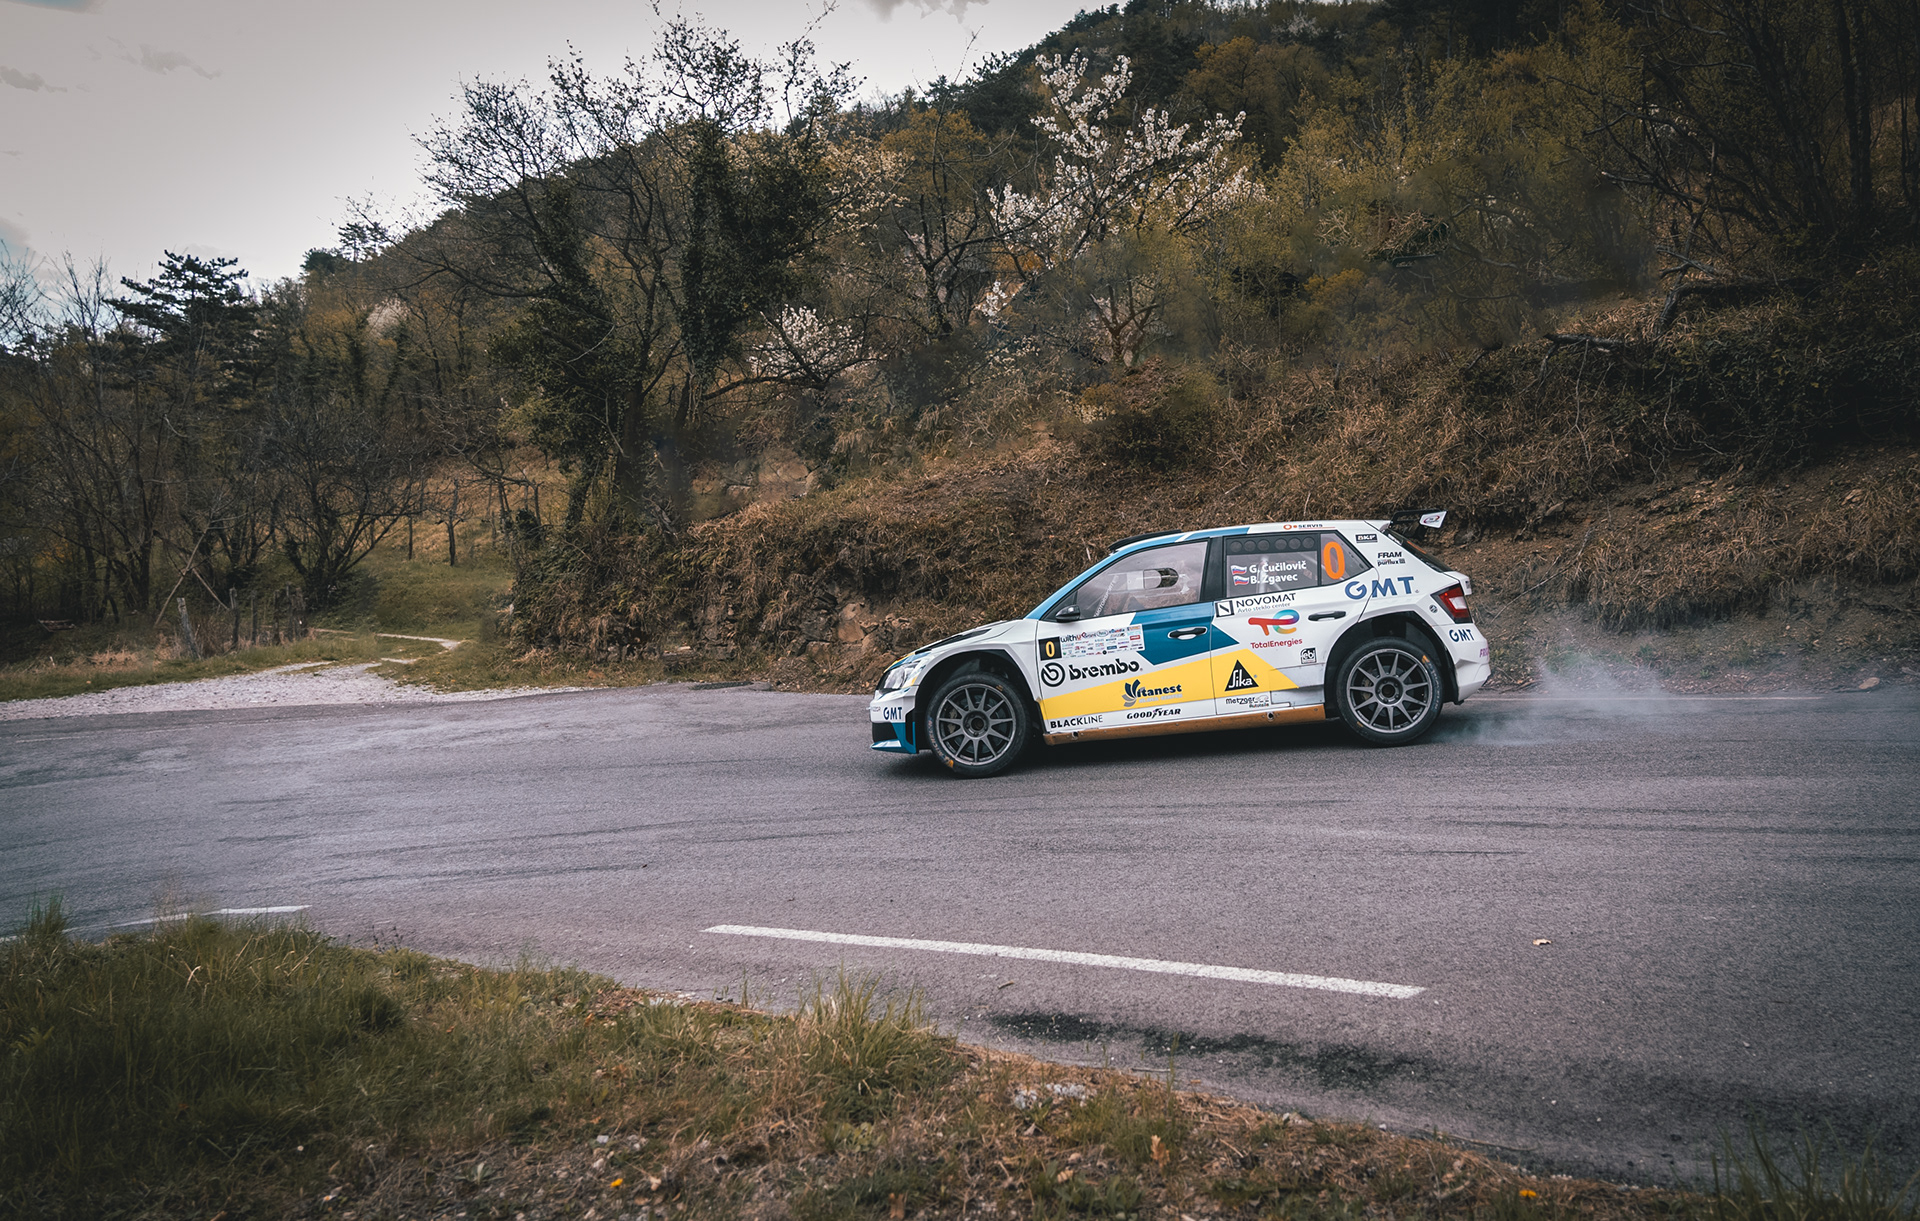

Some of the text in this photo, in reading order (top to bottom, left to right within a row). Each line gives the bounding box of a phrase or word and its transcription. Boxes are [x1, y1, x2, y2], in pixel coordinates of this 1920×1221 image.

[1249, 560, 1307, 574] G. Čučilovič
[1323, 541, 1345, 580] 0
[1250, 576, 1260, 585] B.
[1345, 576, 1415, 600] GMT
[1236, 593, 1297, 608] NOVOMAT
[1253, 604, 1271, 612] steklo
[1449, 628, 1475, 642] GMT
[1045, 641, 1055, 658] 0
[1250, 638, 1303, 649] TotalEnergies
[1068, 658, 1140, 680] brembo
[1228, 669, 1253, 689] Sika
[883, 706, 903, 720] GMT
[1126, 708, 1181, 720] GOODYEAR
[1050, 715, 1104, 729] BLACKLINE
